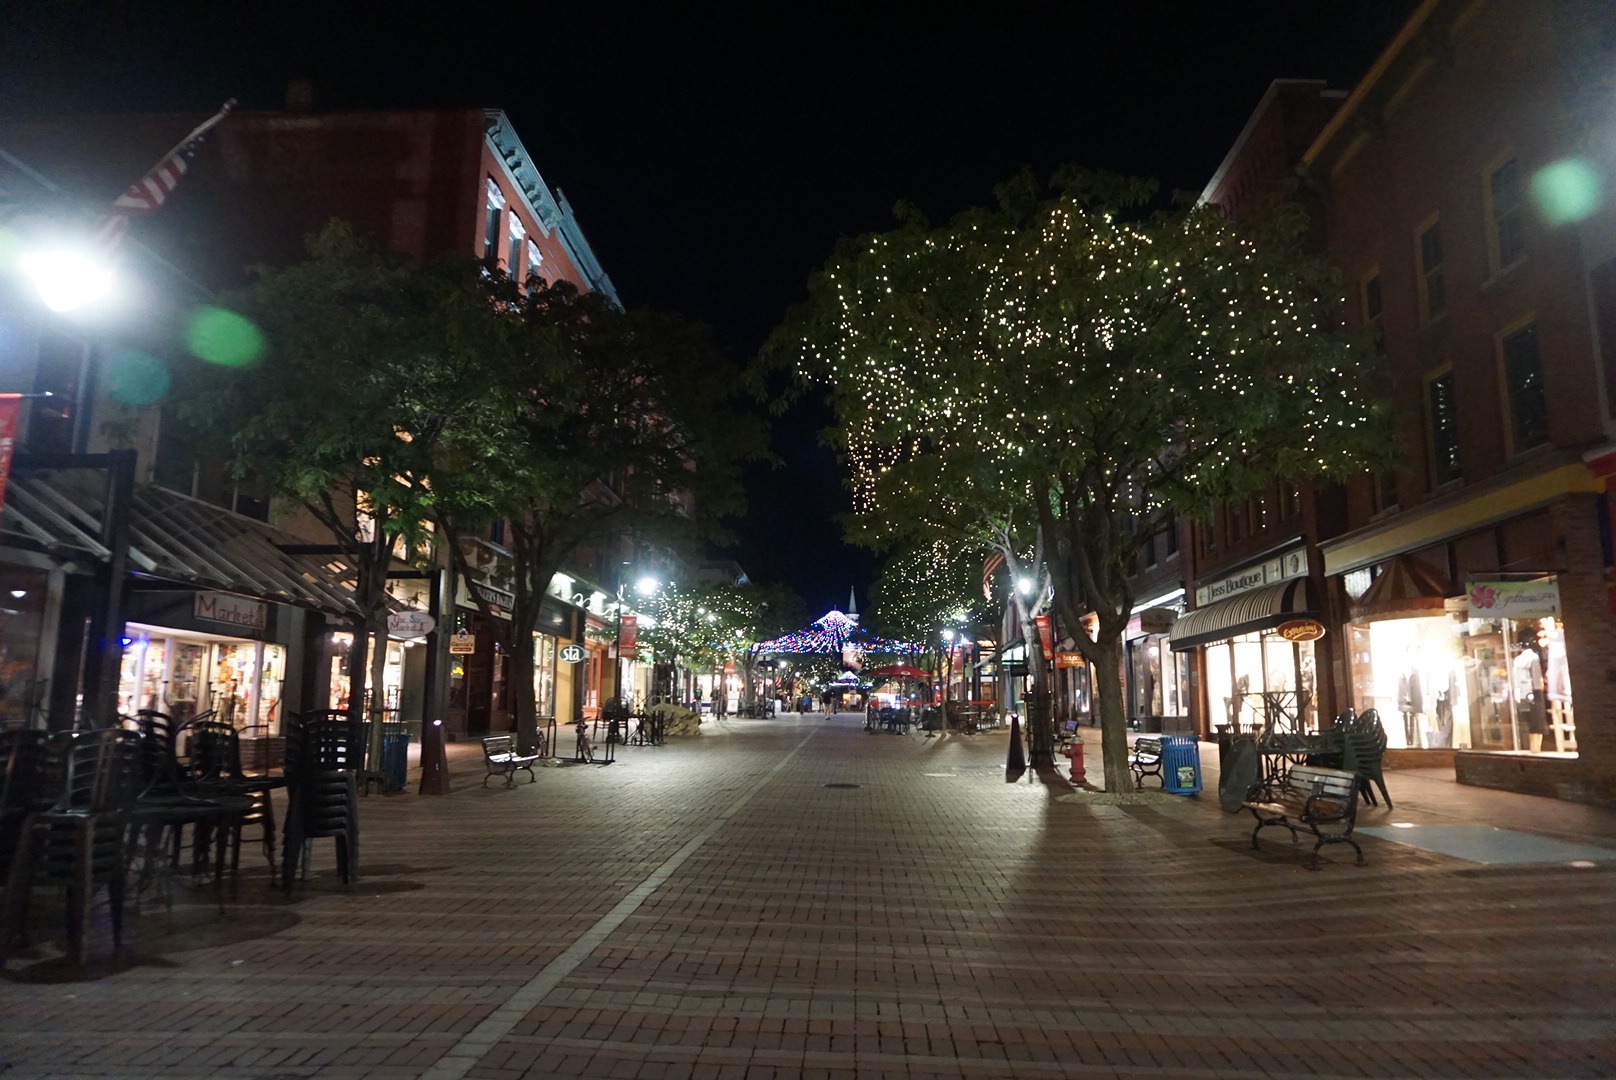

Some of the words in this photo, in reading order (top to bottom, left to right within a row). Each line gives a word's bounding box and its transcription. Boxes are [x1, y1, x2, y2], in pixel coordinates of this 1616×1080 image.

[1225, 572, 1261, 594] Boutique
[197, 594, 255, 625] Market
[563, 646, 579, 660] sta
